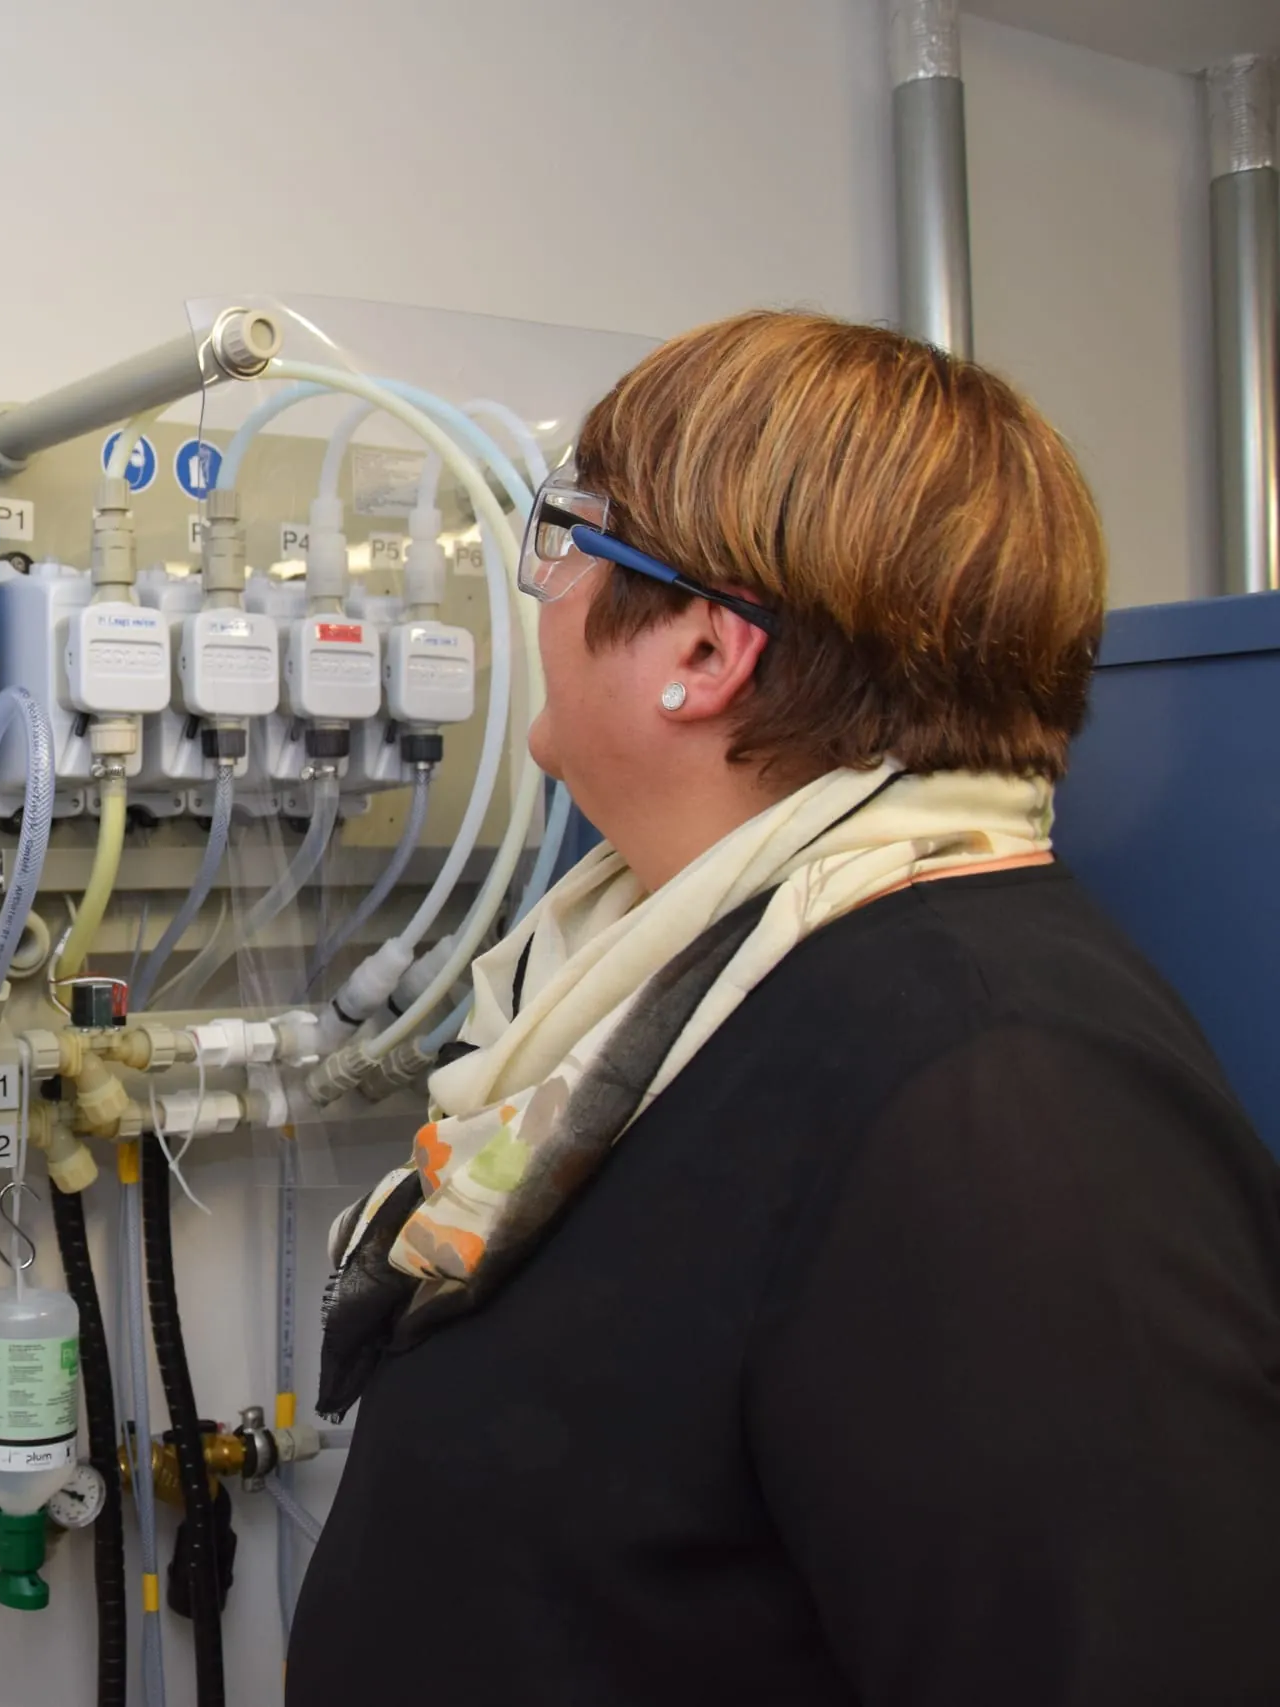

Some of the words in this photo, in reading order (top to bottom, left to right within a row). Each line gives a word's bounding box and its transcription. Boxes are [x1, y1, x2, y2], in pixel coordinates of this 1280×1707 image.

[283, 530, 310, 552] P4
[372, 539, 400, 561] P5
[456, 547, 483, 569] P6
[20, 839, 35, 874] GmbH
[26, 1451, 52, 1464] plum
